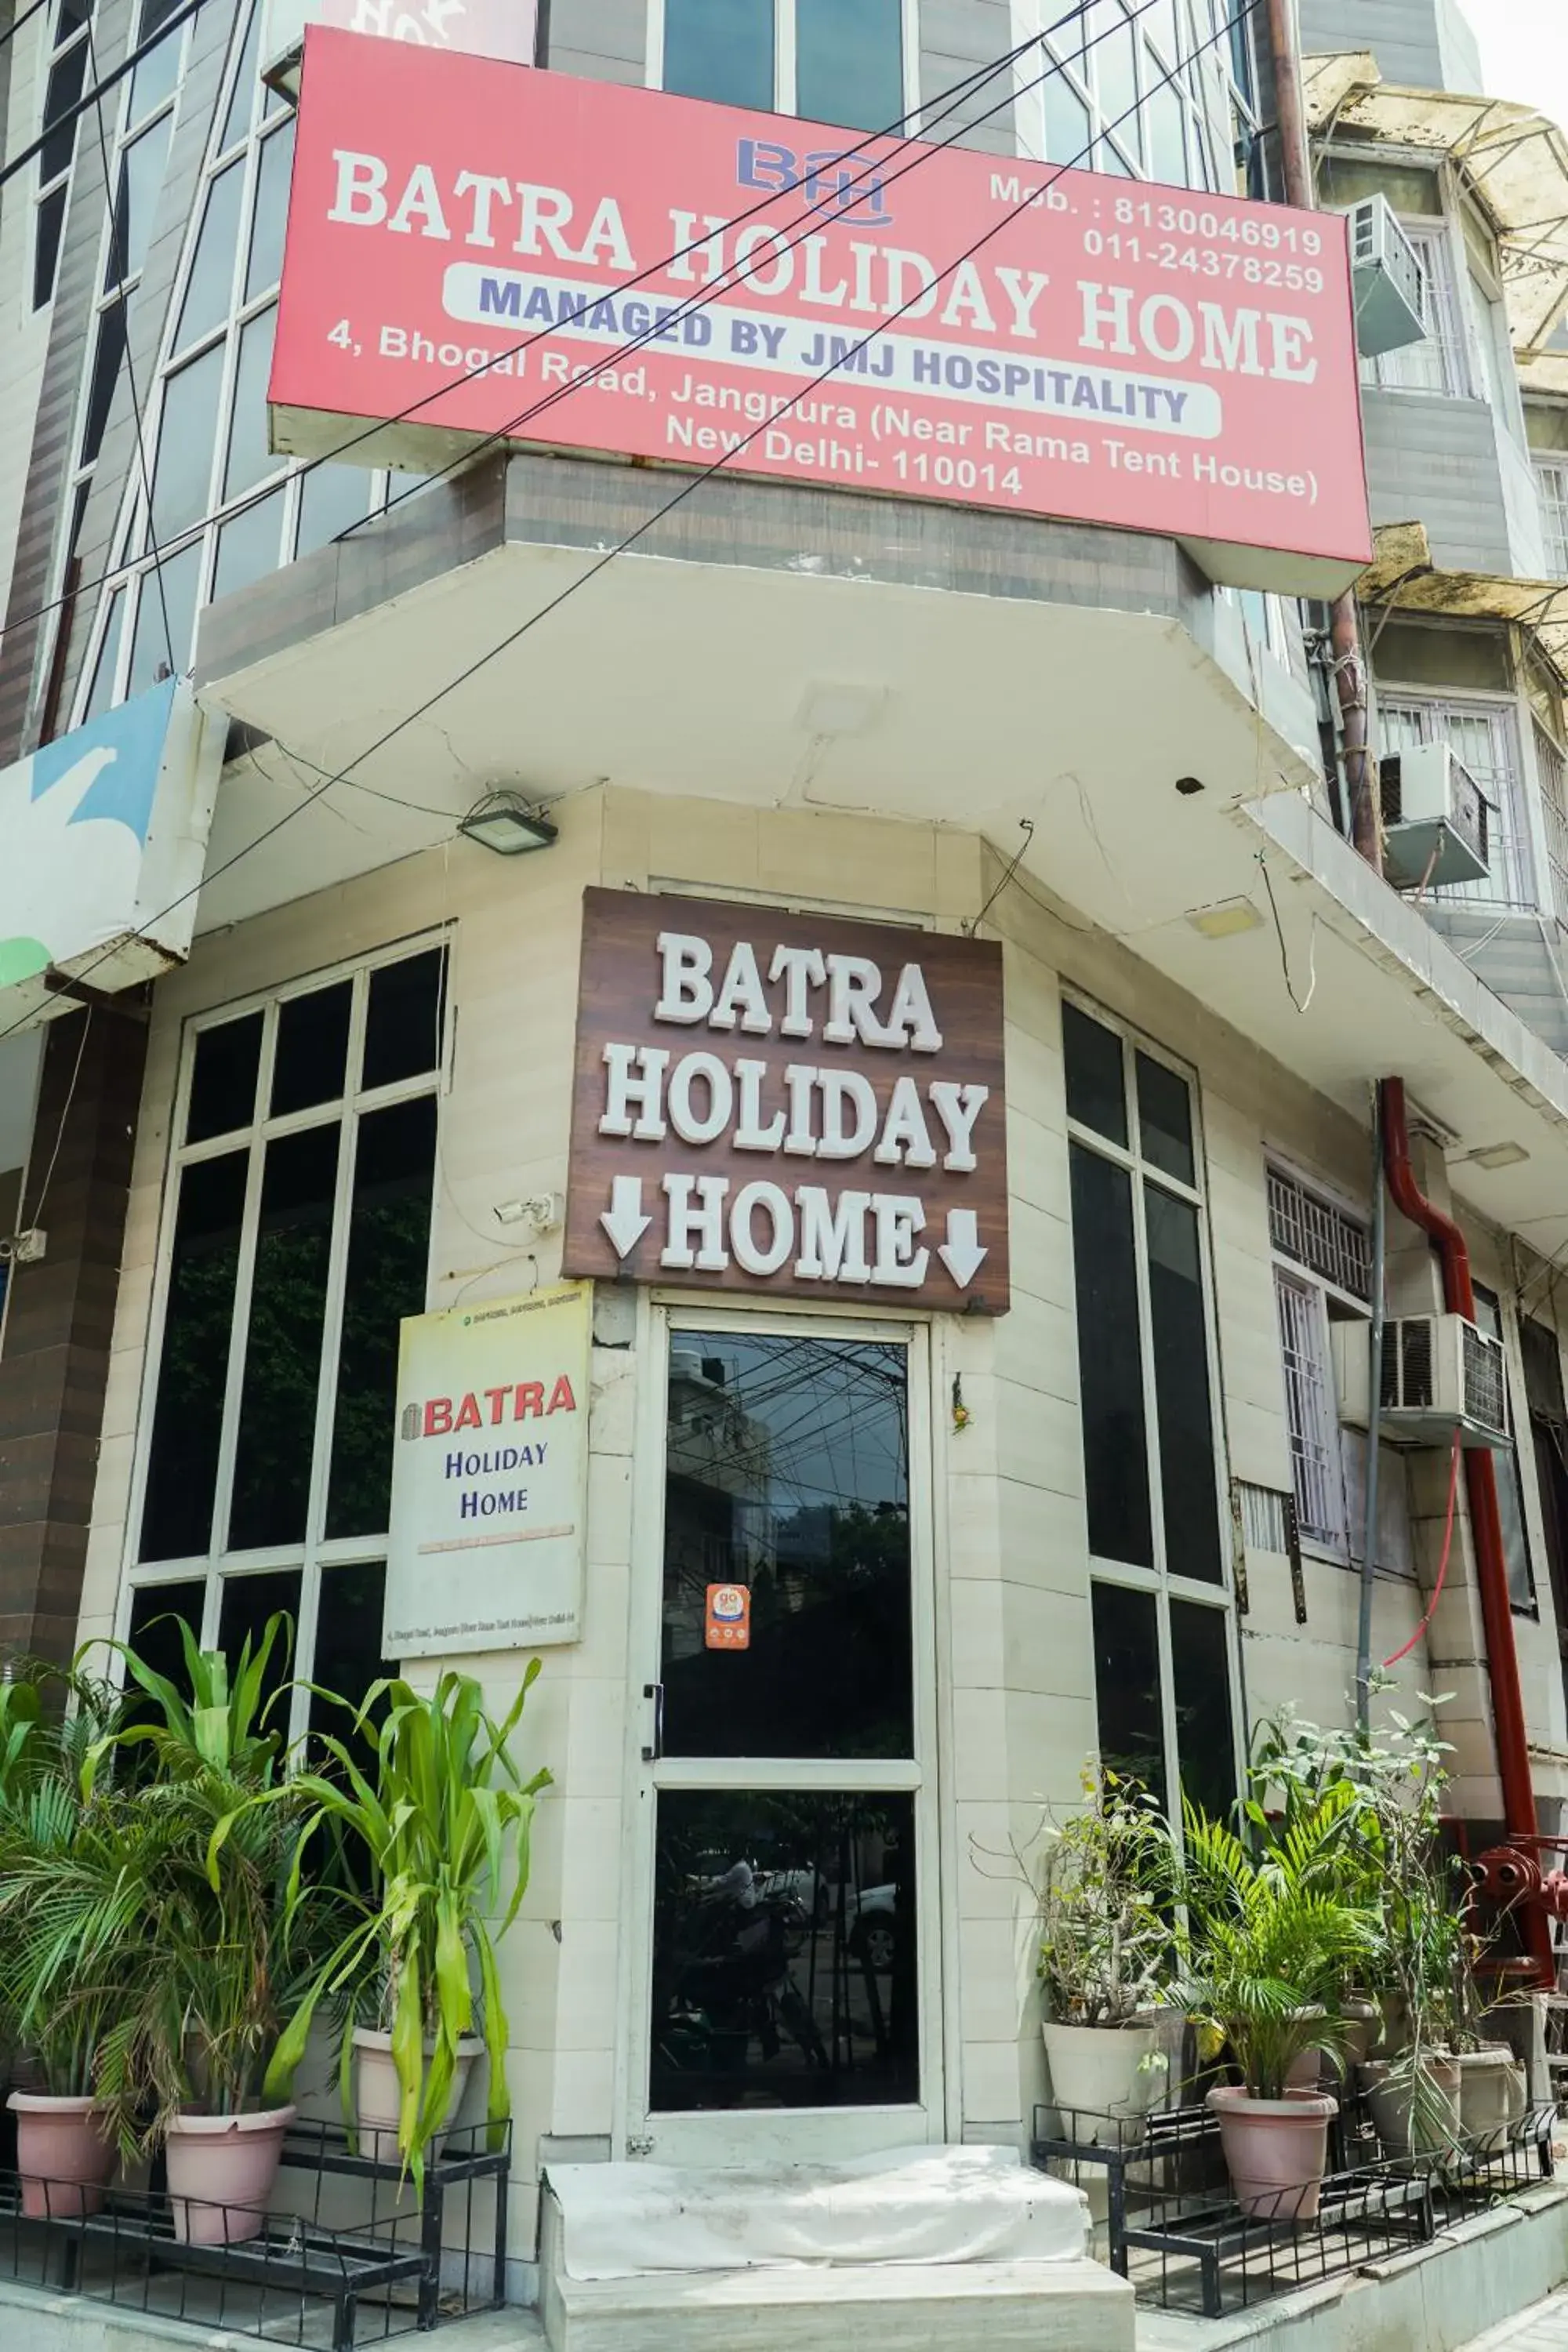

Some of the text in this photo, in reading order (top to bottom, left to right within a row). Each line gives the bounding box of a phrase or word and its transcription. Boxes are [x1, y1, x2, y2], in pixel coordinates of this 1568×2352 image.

[989, 173, 1077, 214] Mob.
[1115, 198, 1322, 256] 8130046919
[1084, 230, 1323, 294] 011-24378259
[327, 149, 1318, 384] BATRA HOLIDAY HOME
[479, 278, 1188, 423] MANAGED BY JMJ HOSPITALITY
[327, 319, 1318, 505] 4, Bhogal Road, Jangpura (Near Rama Tent House)
[666, 414, 1022, 495] New Delhi- 110014
[655, 932, 942, 1052] BATRA
[599, 1043, 989, 1171] HOLIDAY
[660, 1173, 930, 1287] HOME
[423, 1374, 576, 1438] BATRA
[445, 1443, 548, 1479] HOLIDAY
[460, 1489, 528, 1519] HOME
